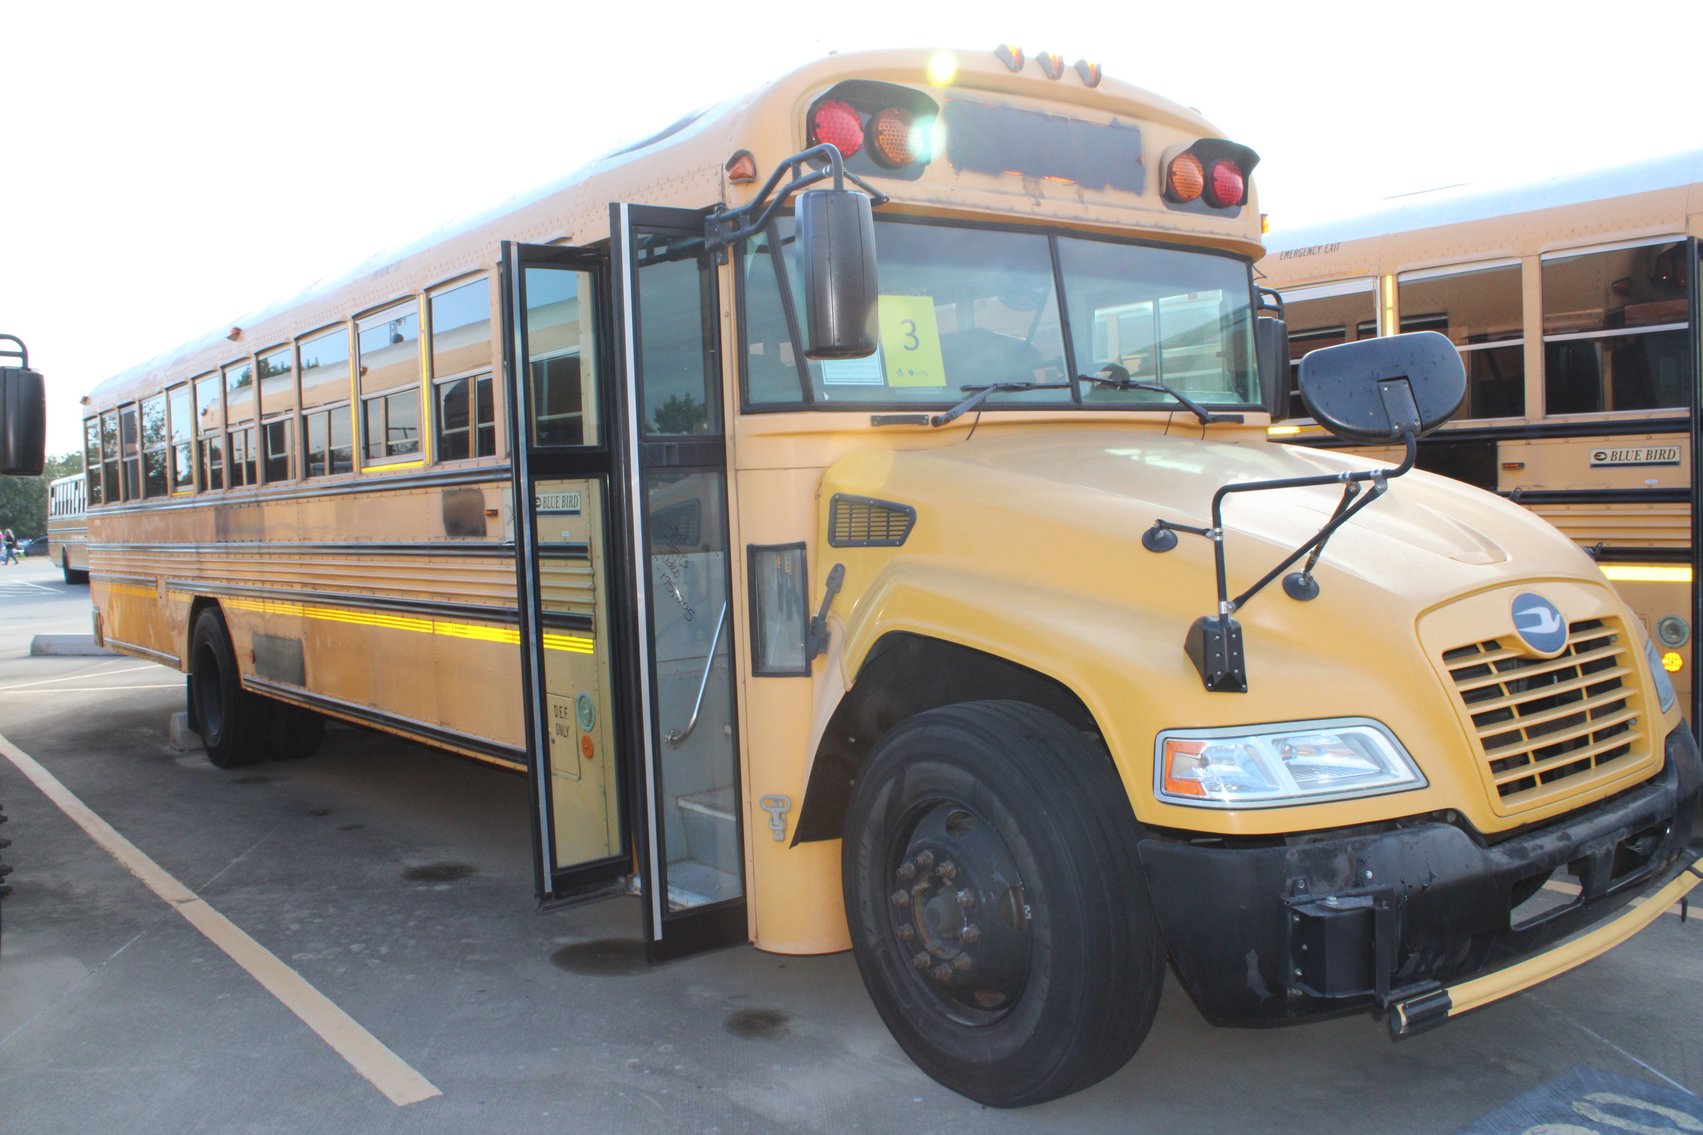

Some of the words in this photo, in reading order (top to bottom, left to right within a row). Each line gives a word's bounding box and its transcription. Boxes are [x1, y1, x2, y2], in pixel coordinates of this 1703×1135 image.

[1280, 244, 1323, 260] EMERGENCY
[1324, 241, 1341, 254] EXIT
[901, 319, 920, 351] 3
[1610, 450, 1642, 462] BLUE
[1645, 448, 1676, 461] BIRD
[542, 496, 560, 509] BLUE
[561, 495, 579, 508] BIRD
[555, 722, 569, 738] ONLY
